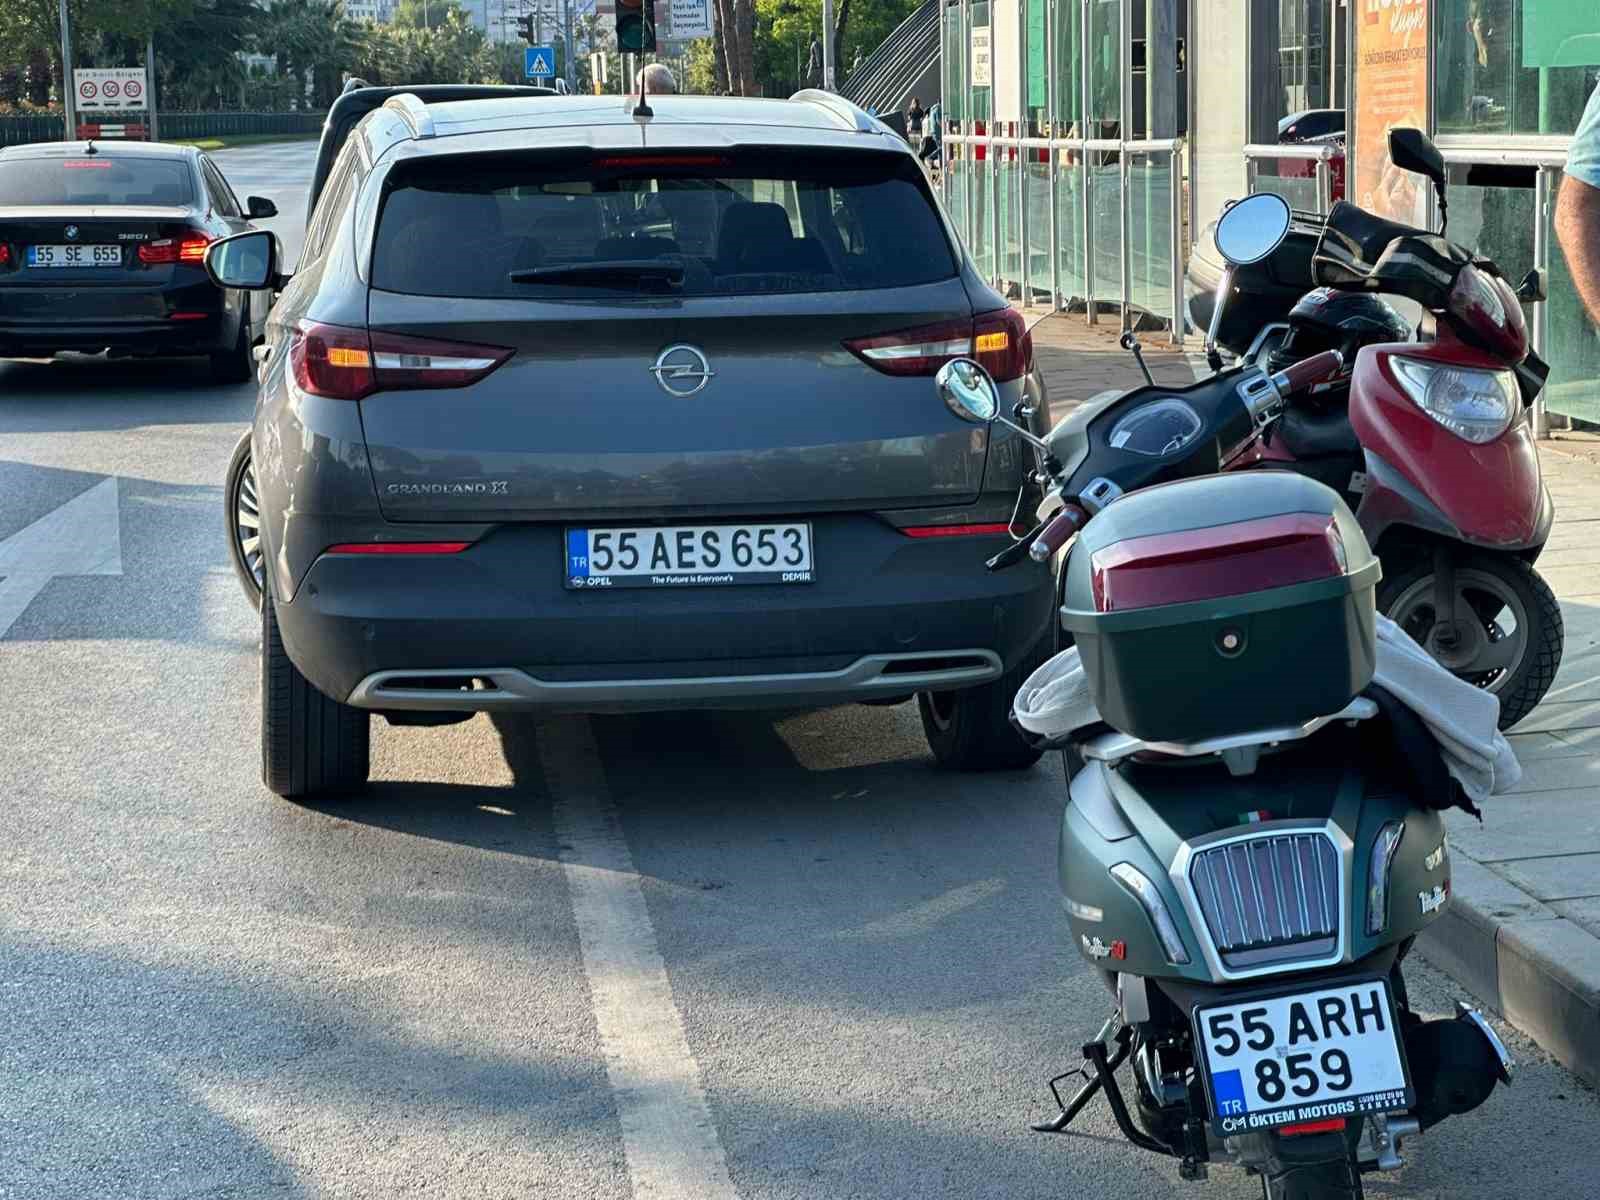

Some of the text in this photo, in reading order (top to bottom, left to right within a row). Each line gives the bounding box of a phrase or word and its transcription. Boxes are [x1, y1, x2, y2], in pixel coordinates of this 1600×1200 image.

[84, 85, 138, 94] 60 50 50
[37, 246, 119, 261] 55 SE 655
[387, 481, 508, 494] GRANDLAND X
[593, 528, 804, 571] 55 AES 653
[571, 557, 588, 568] TR
[587, 577, 612, 586] OPEL
[666, 576, 690, 584] Future
[697, 574, 733, 584] Everyone's
[1209, 990, 1385, 1057] 55 ARH
[1255, 1048, 1352, 1103] 859
[1222, 1100, 1243, 1115] TR
[1249, 1110, 1296, 1128] ÖKTEM
[1299, 1101, 1355, 1120] MOTORS
